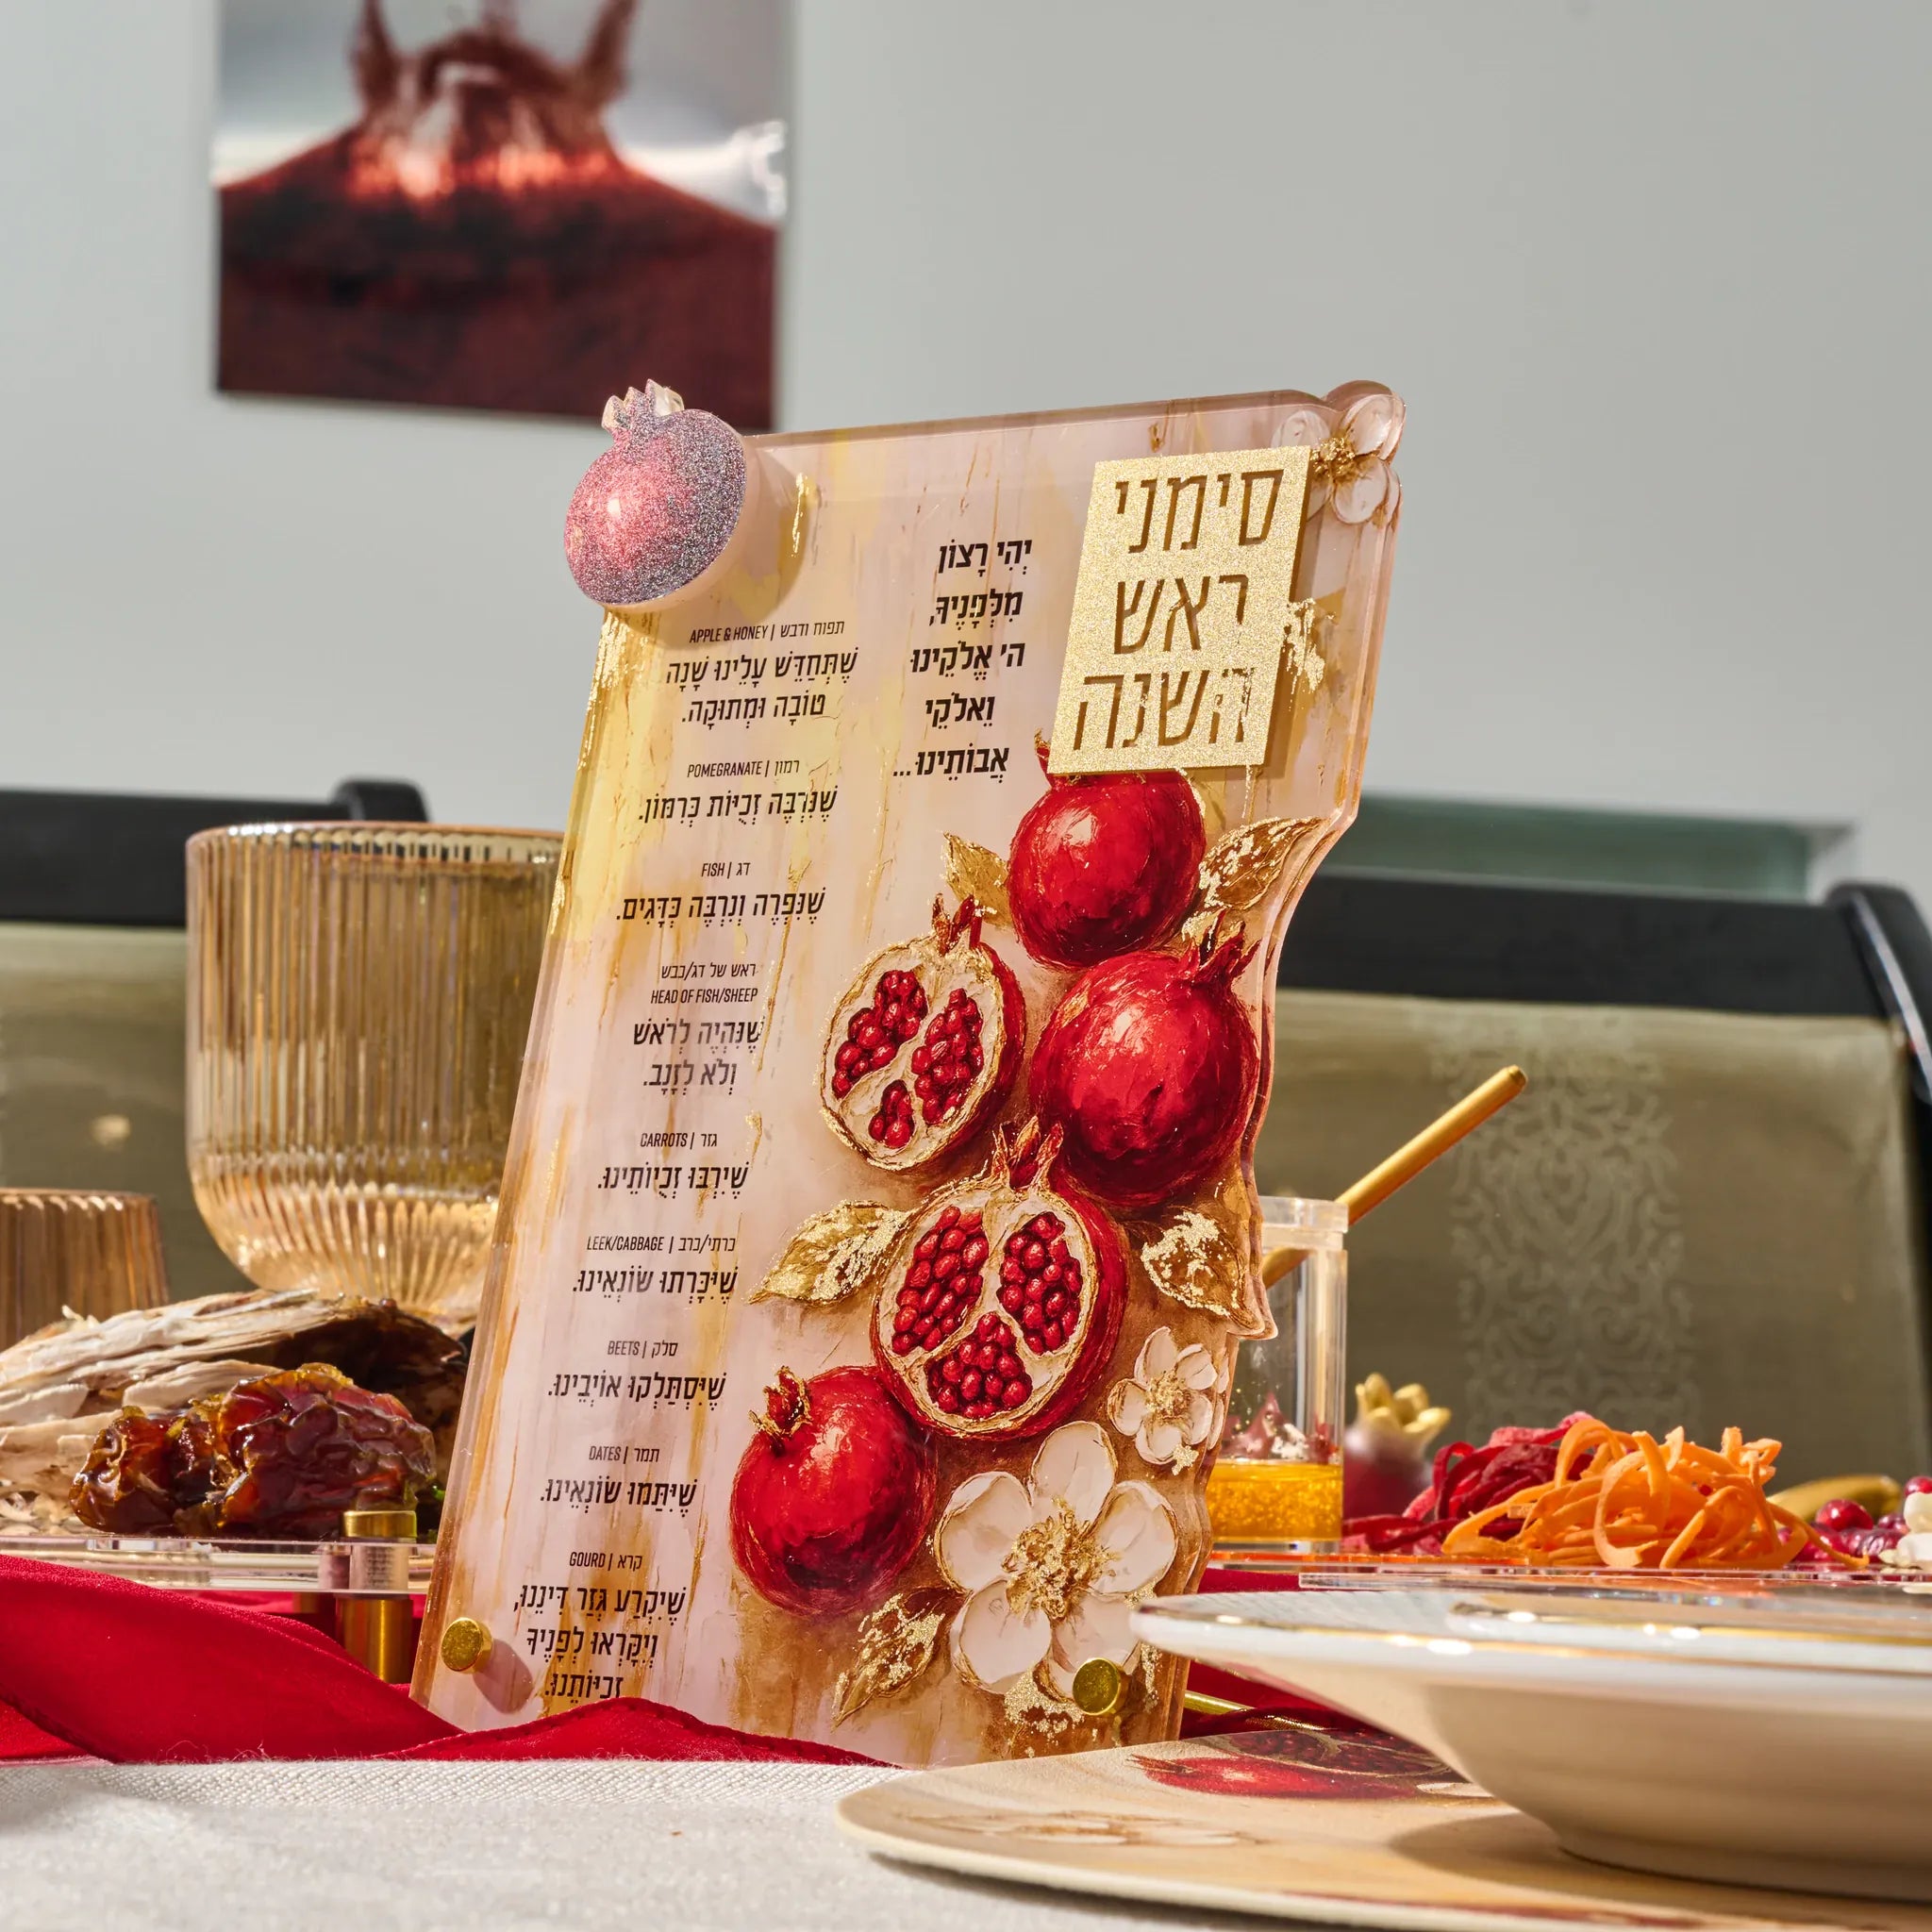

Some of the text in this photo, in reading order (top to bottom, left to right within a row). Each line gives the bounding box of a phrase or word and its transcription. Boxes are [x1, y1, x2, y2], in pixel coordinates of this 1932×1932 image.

[1114, 468, 1285, 555] סימני
[938, 539, 1033, 578] יְהִי רָצוֹן
[1113, 573, 1250, 655] ראש
[689, 628, 723, 643] APPLE
[724, 627, 732, 641] &
[733, 625, 769, 641] HONEY
[780, 624, 809, 639] ודבש
[813, 621, 845, 638] תפוח
[909, 640, 993, 681] אֱלֹקֵינוּ
[665, 656, 709, 692] שָׁנָה
[713, 655, 767, 689] עָלֵינוּ
[773, 690, 826, 726] טוֹבָה
[924, 691, 996, 730] וֵאלֹקֵי
[1073, 666, 1256, 752] השנה
[687, 760, 762, 778] POMEGRANATE
[774, 759, 800, 776] רמון
[701, 862, 725, 877] FISH
[736, 862, 751, 876] דג
[661, 961, 758, 981] ראש של דג/כבש
[650, 988, 758, 1005] HEAD OF FISH/SHEEP
[640, 1132, 689, 1147] CARROTS
[701, 1133, 718, 1147] גזר
[586, 1235, 665, 1252] LEEK/CABBAGE
[678, 1234, 736, 1254] כרתי/כרב
[607, 1340, 641, 1356] BEETS
[651, 1340, 678, 1358] סלק
[589, 1445, 622, 1461] DATES
[634, 1447, 660, 1463] תמר
[569, 1551, 607, 1568] GOURD
[617, 1554, 643, 1573] קרא
